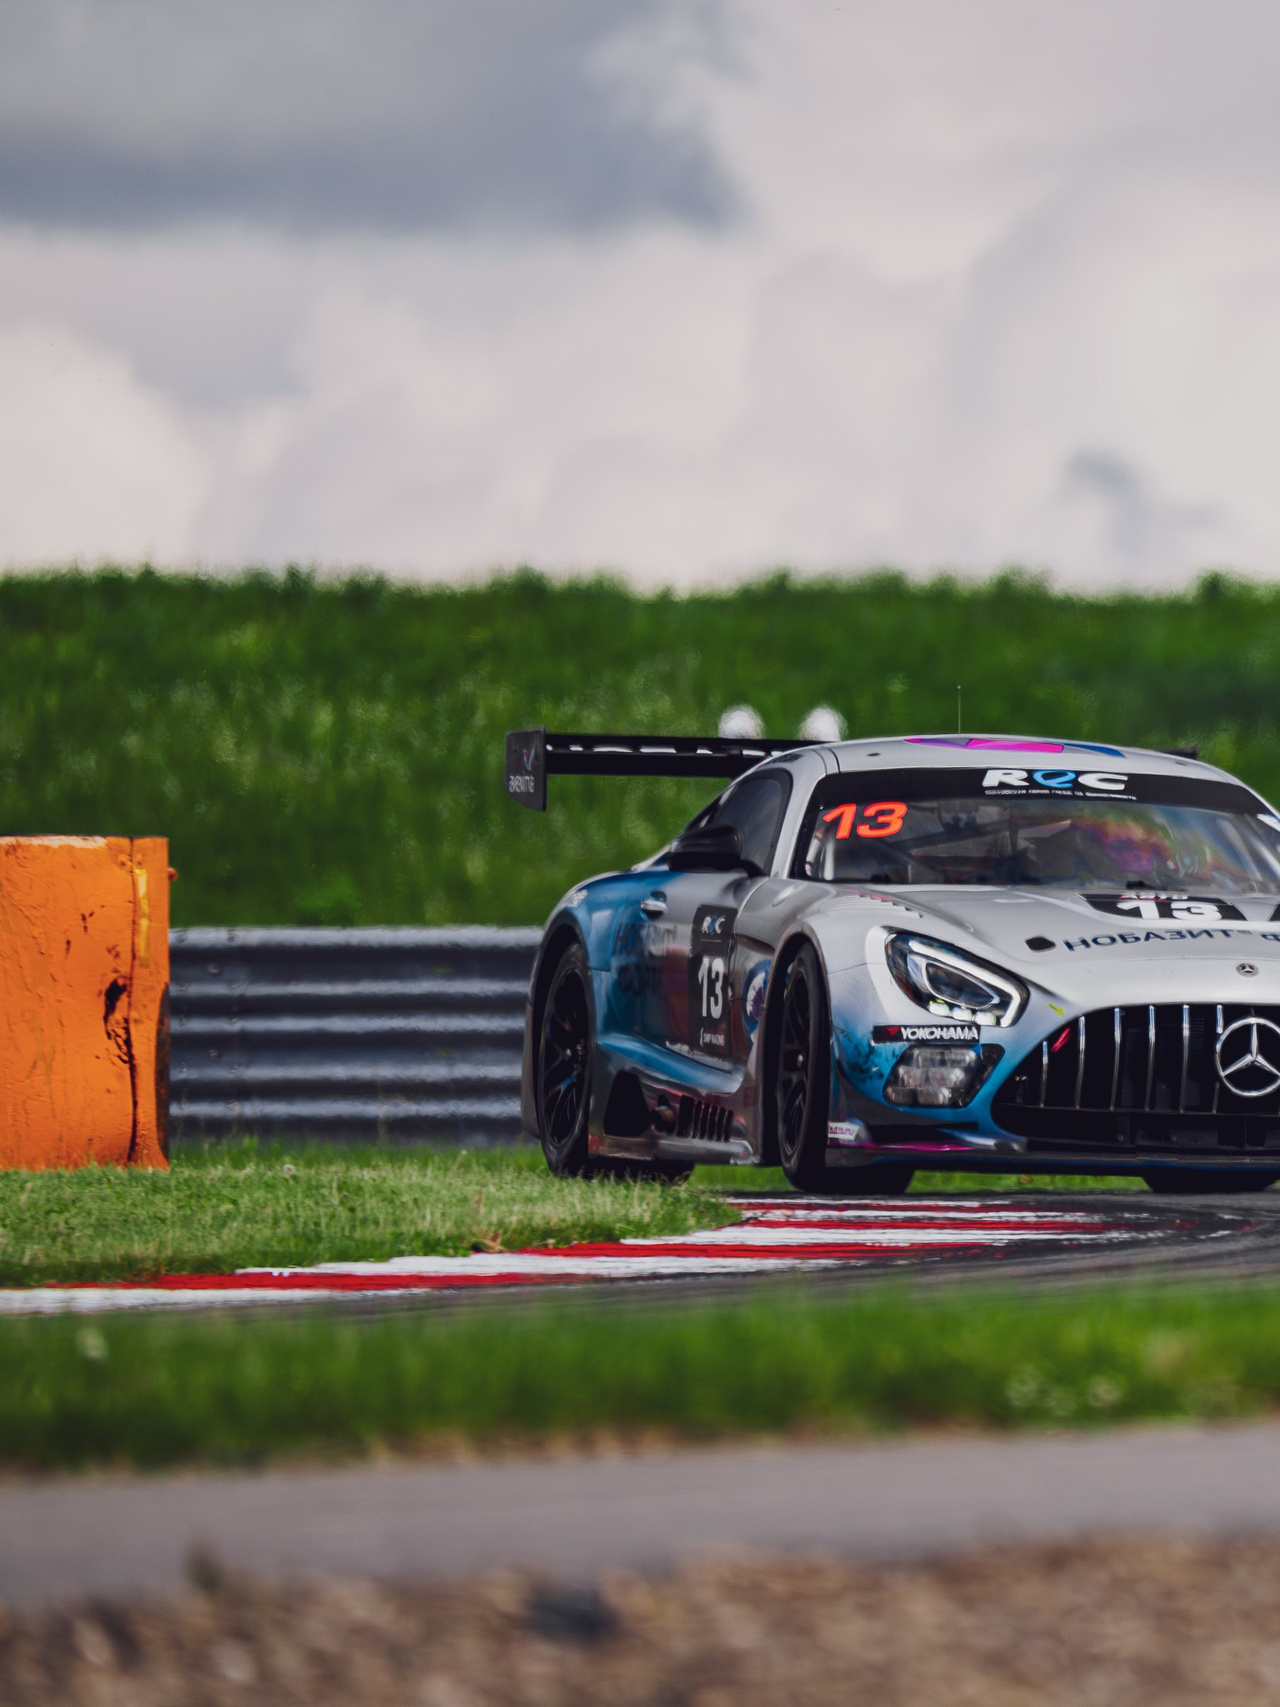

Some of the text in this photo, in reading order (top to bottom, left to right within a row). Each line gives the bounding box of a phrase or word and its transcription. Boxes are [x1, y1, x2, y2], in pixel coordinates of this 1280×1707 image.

[822, 801, 908, 840] 13
[1116, 901, 1223, 921] 13
[1062, 928, 1233, 952] НОБАЗИТ
[698, 957, 725, 1019] 13
[900, 1026, 979, 1040] YOKOHAMA
